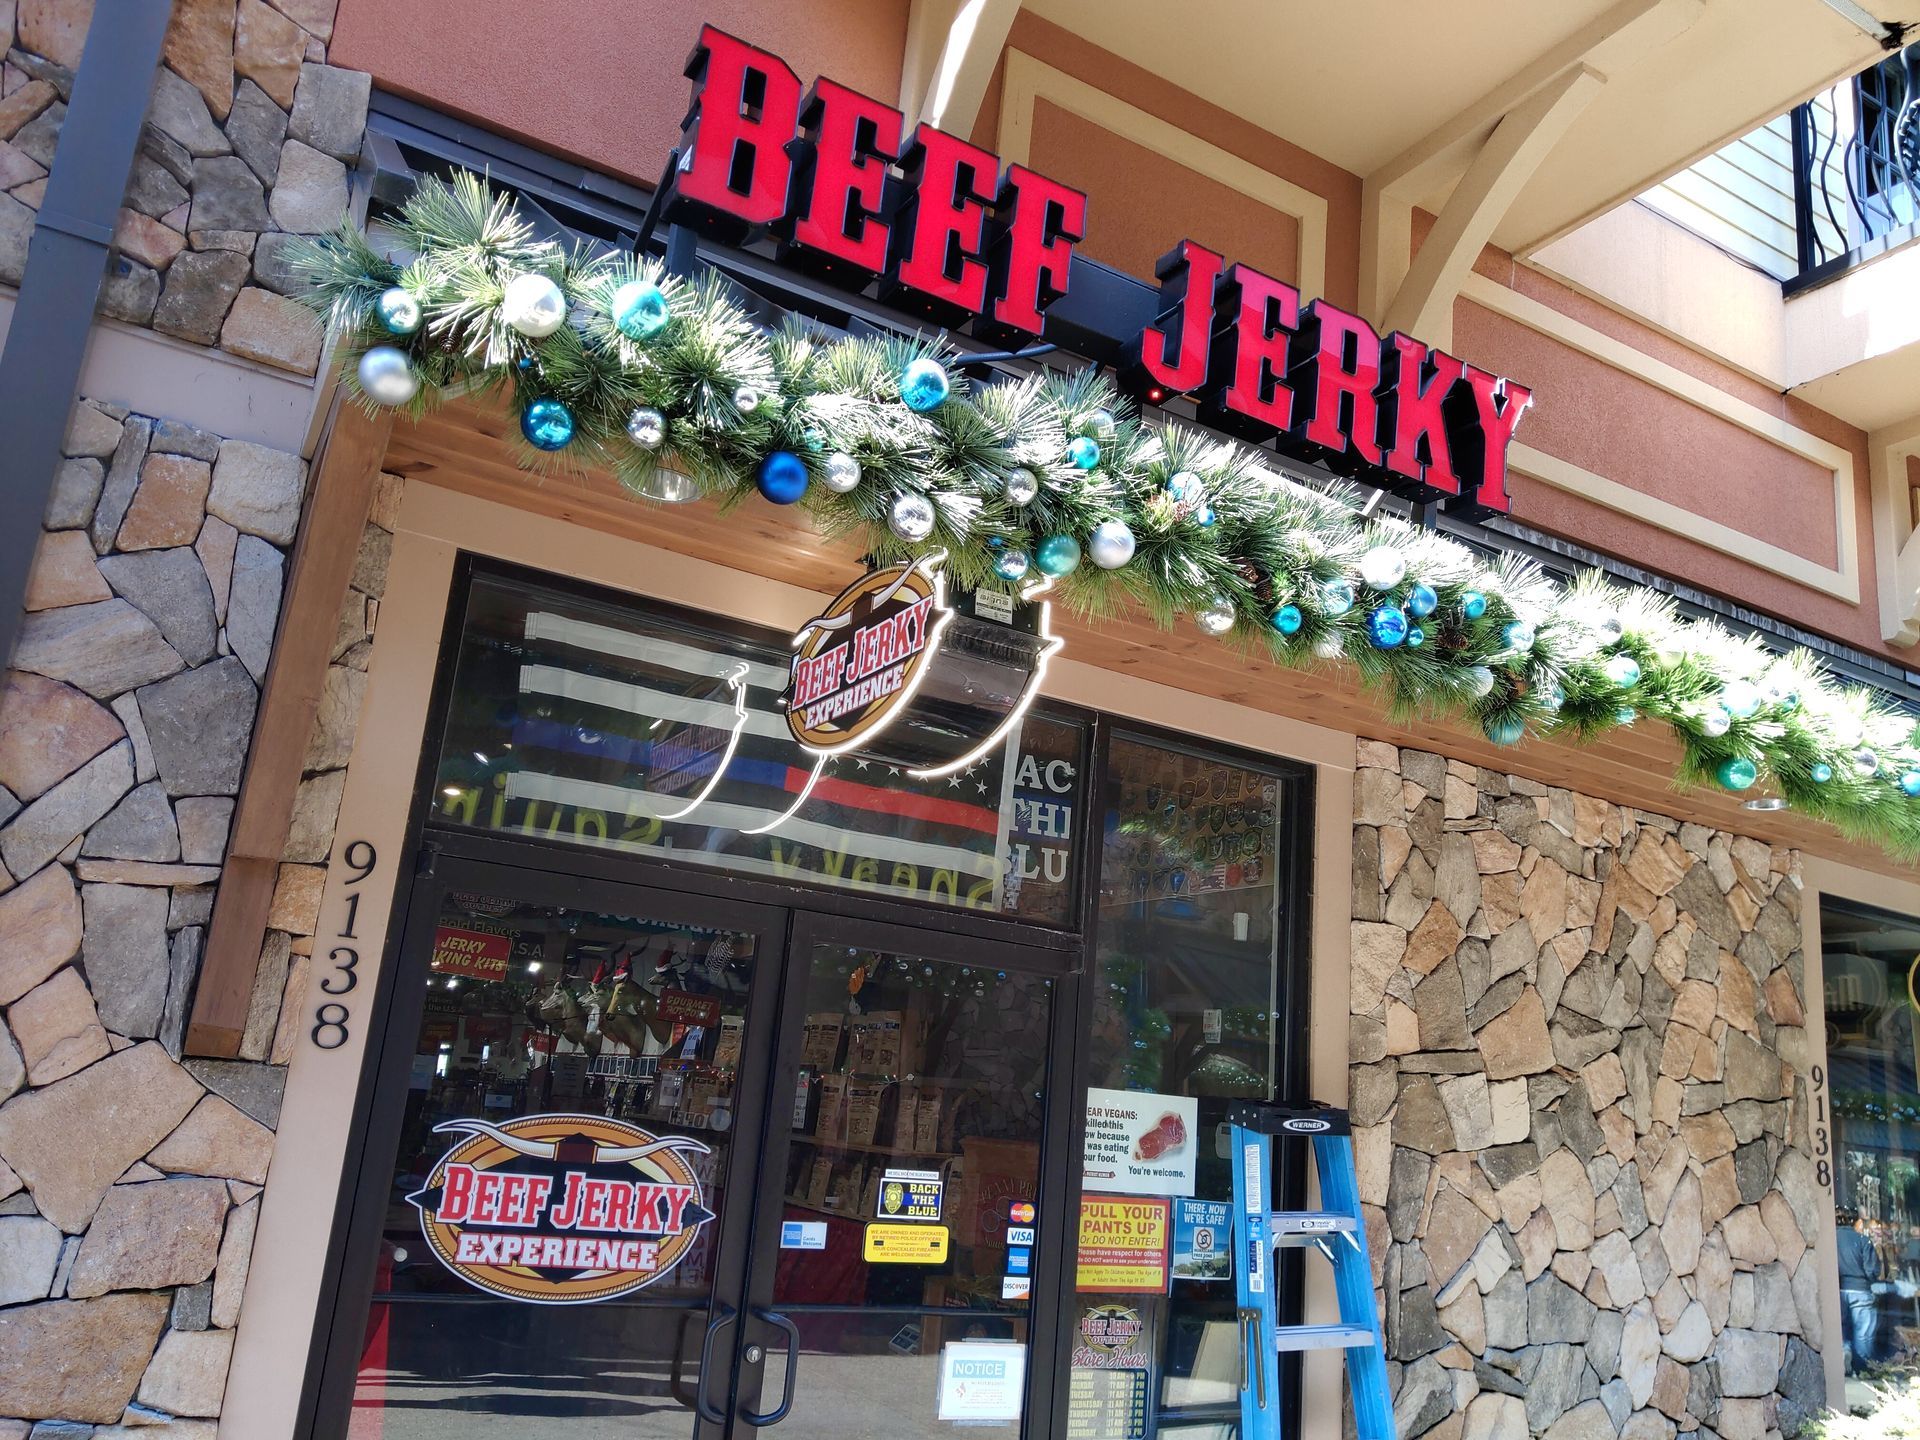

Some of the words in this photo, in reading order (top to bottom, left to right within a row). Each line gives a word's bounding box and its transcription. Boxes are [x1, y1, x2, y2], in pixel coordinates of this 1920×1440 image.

[677, 23, 1087, 337] BEEF
[1140, 239, 1534, 514] JERKY
[792, 641, 849, 711] BEEF
[846, 595, 934, 685] JERKY
[804, 664, 905, 731] EXPERIENCE
[474, 920, 521, 938] Flavors
[311, 841, 377, 1050] 9138
[441, 936, 486, 954] JERKY
[474, 956, 506, 972] KITS
[667, 995, 713, 1010] GOURMET
[1105, 1108, 1138, 1120] VEGANS:
[1109, 1119, 1124, 1130] this
[1292, 1121, 1322, 1129] WERNER
[1811, 1064, 1831, 1188] 9138
[1084, 1131, 1095, 1139] ow
[1097, 1130, 1130, 1142] because
[1104, 1143, 1130, 1155] eating
[1097, 1152, 1118, 1163] food.
[1128, 1165, 1151, 1176] You're
[1153, 1167, 1186, 1178] welcome.
[909, 1183, 939, 1195] BACK
[435, 1162, 553, 1228] BEEF
[550, 1171, 695, 1236] JERKY
[912, 1195, 935, 1206] THE
[908, 1206, 938, 1217] BLUE
[1080, 1205, 1117, 1218] PULL
[1122, 1206, 1162, 1220] YOUR
[1184, 1202, 1207, 1214] THERE,
[1209, 1204, 1227, 1215] NOW
[1184, 1213, 1205, 1224] WE'RE
[1206, 1214, 1225, 1226] SAFE!
[1083, 1220, 1132, 1234] PANTS
[1137, 1222, 1156, 1235] UP
[1011, 1231, 1032, 1242] VISA
[1080, 1235, 1089, 1244] Or
[1092, 1235, 1105, 1244] DO
[1108, 1236, 1127, 1245] NOT
[1128, 1237, 1160, 1246] ENTER!
[453, 1232, 660, 1272] EXPERIENCE
[1097, 1248, 1111, 1256] have
[1112, 1249, 1133, 1258] respect
[1004, 1282, 1029, 1290] DISCOVER
[1081, 1317, 1107, 1336] BEEF
[1107, 1317, 1142, 1336] JERKY
[1091, 1335, 1129, 1345] OUTLET
[1072, 1346, 1104, 1367] Store
[1107, 1345, 1149, 1368] Hours
[955, 1362, 1003, 1376] NOTICE
